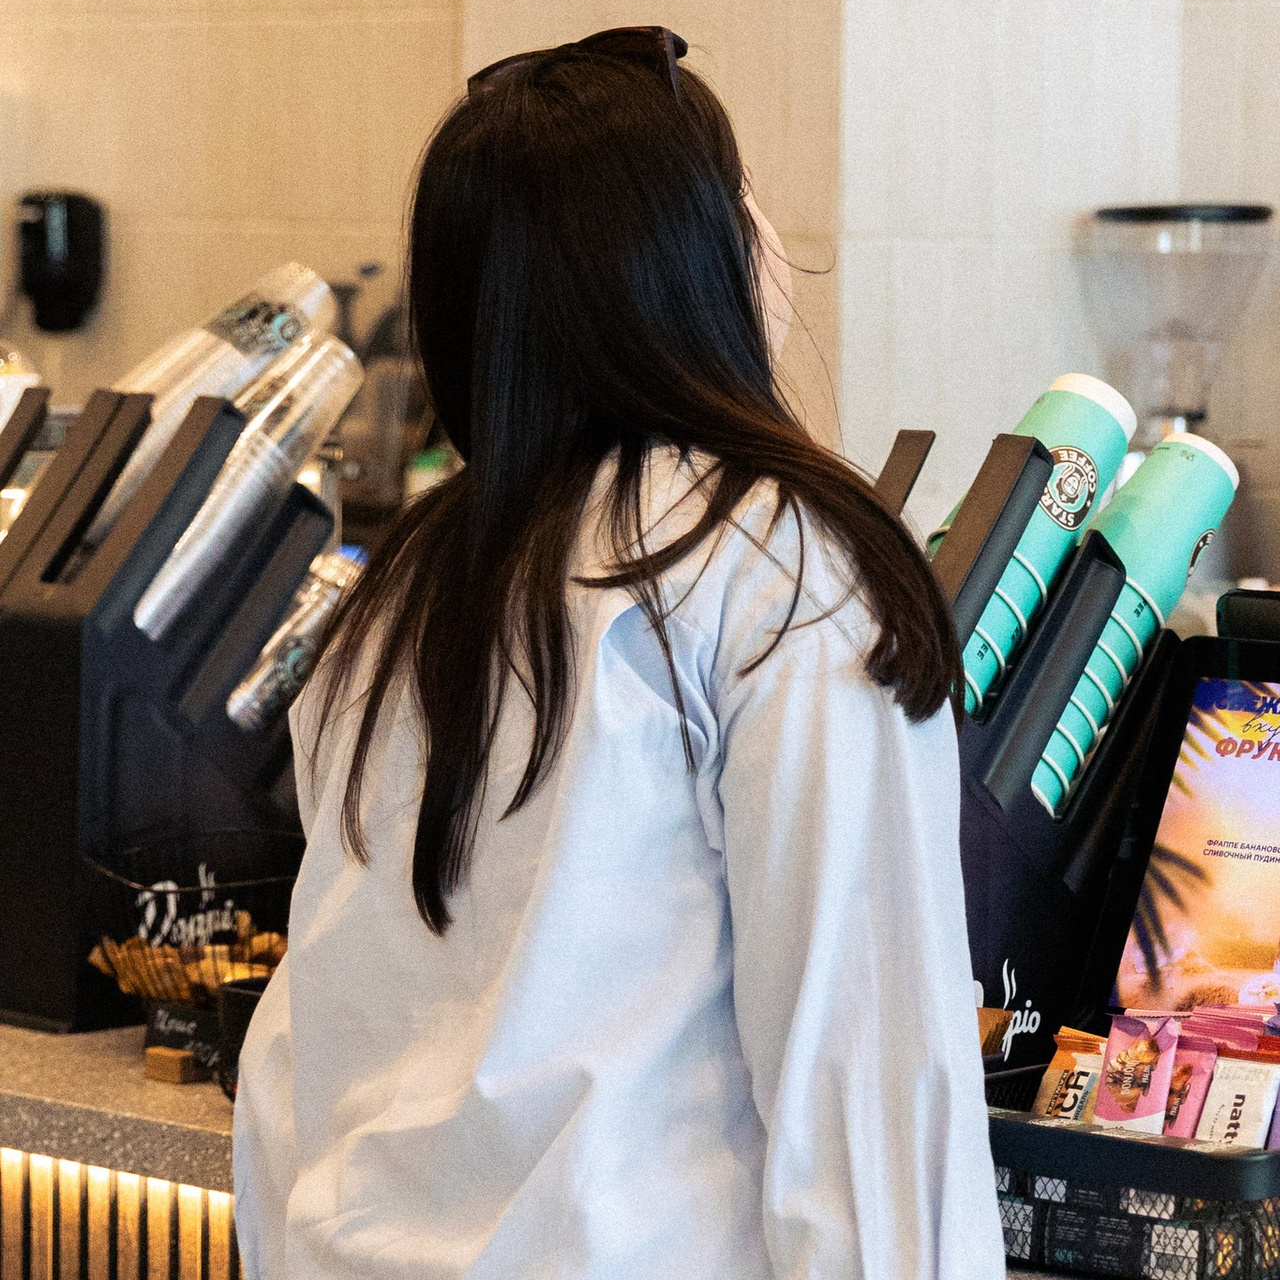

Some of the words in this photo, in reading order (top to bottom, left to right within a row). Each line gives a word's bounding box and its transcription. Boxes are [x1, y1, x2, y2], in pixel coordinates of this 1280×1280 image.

[1206, 839, 1239, 849] ФРАППЕ
[1202, 848, 1253, 861] СЛИВОЧНЫЙ
[1073, 1090, 1089, 1121] ИНДАЛЬ
